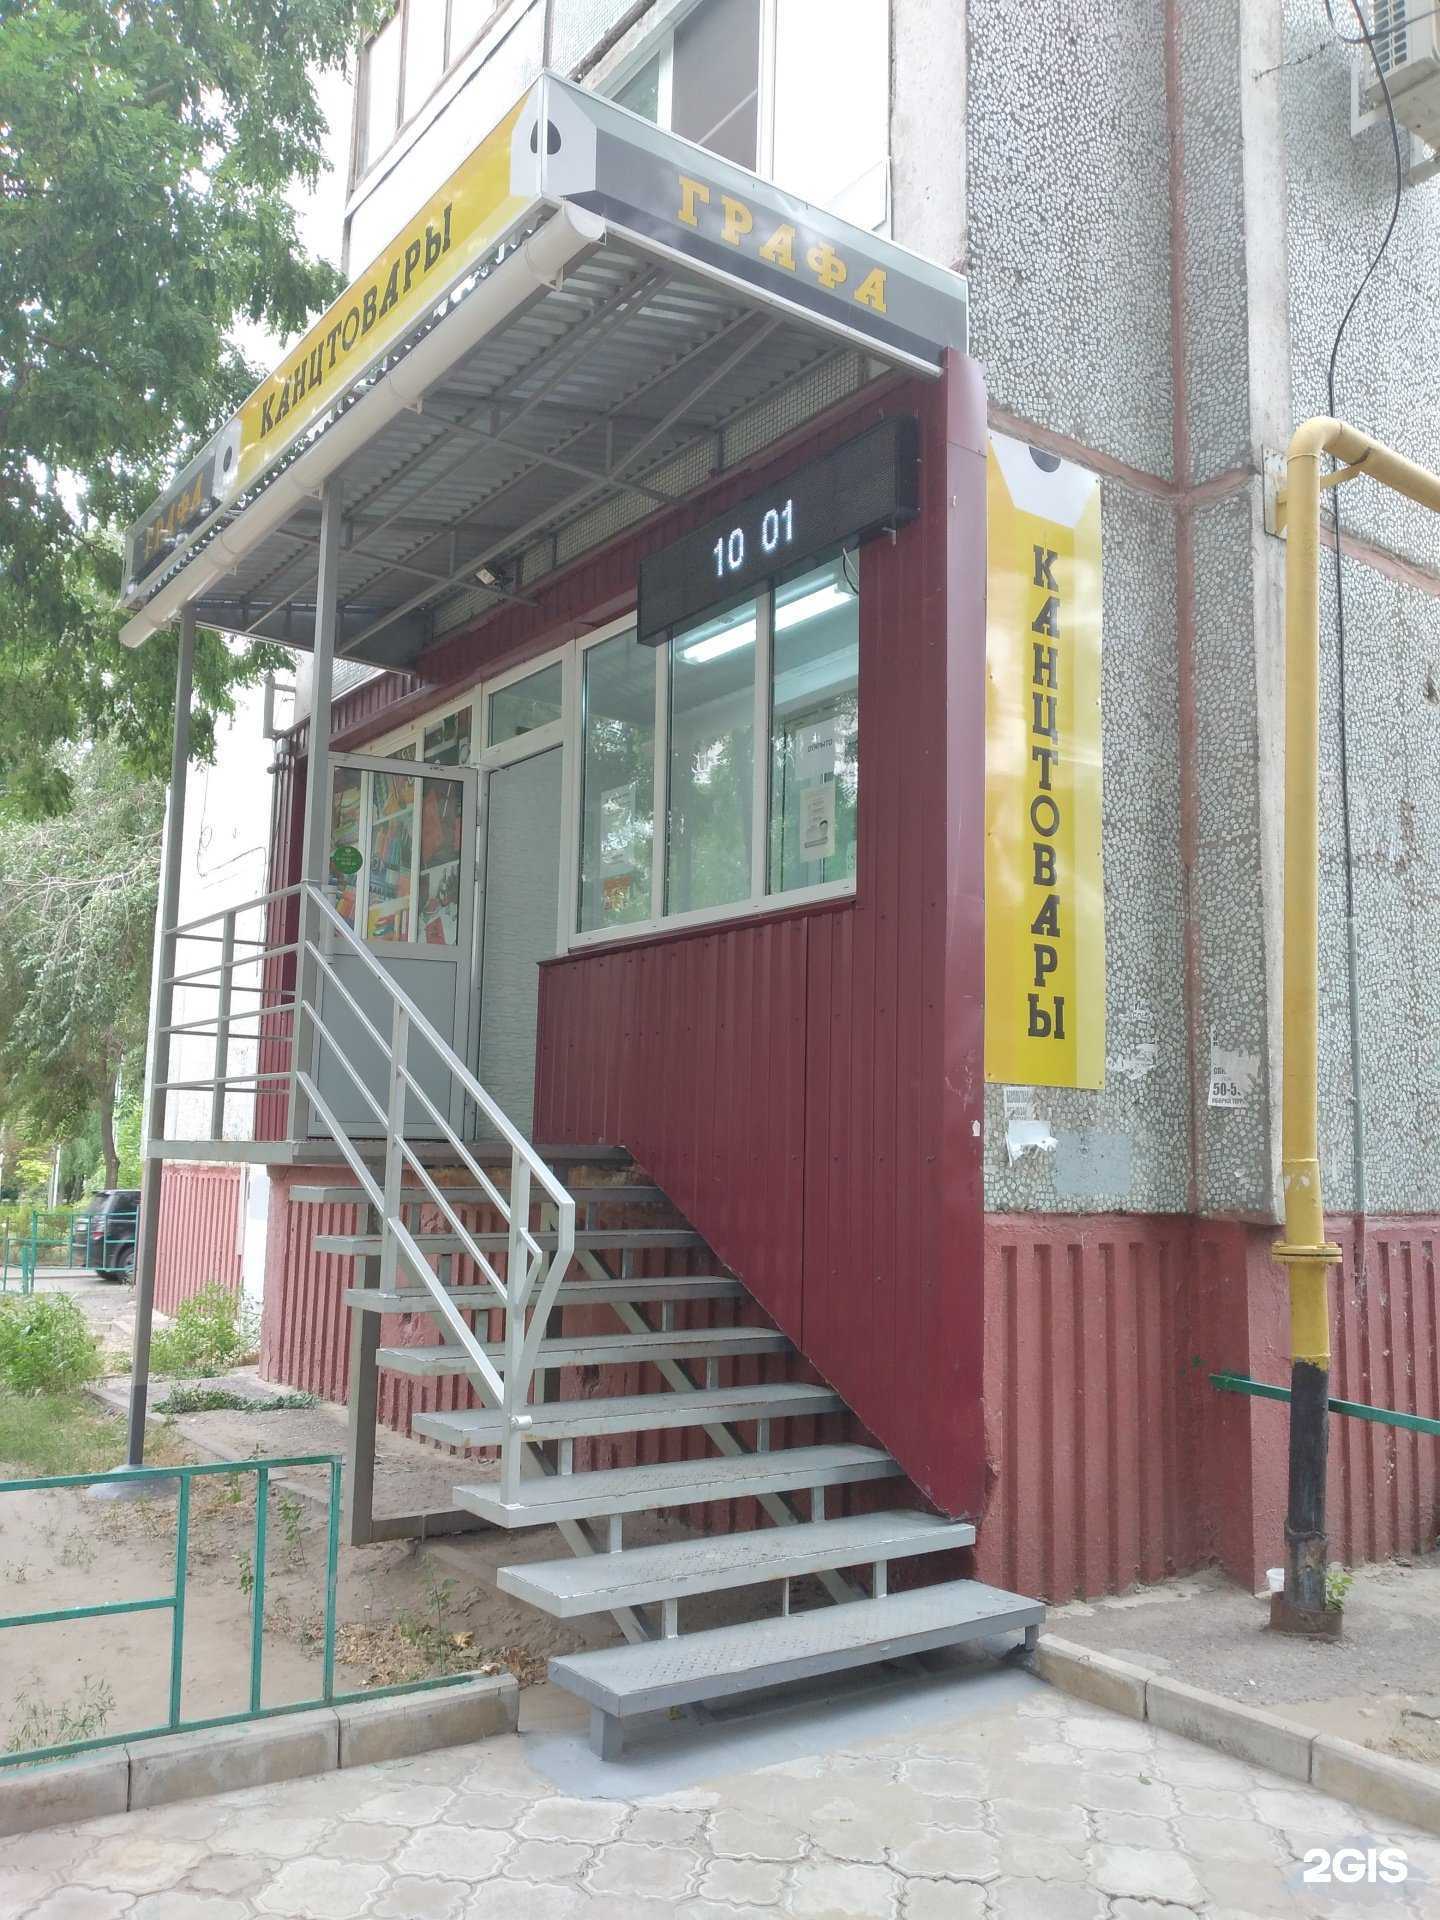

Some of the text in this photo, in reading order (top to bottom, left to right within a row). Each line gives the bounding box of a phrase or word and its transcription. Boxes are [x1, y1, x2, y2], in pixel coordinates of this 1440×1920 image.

[260, 202, 453, 438] КАНЦТОВАРЫ
[677, 175, 888, 313] ГРАФА
[713, 499, 792, 576] 10 01
[1027, 545, 1066, 1040] КАНЦТОВАРЫ
